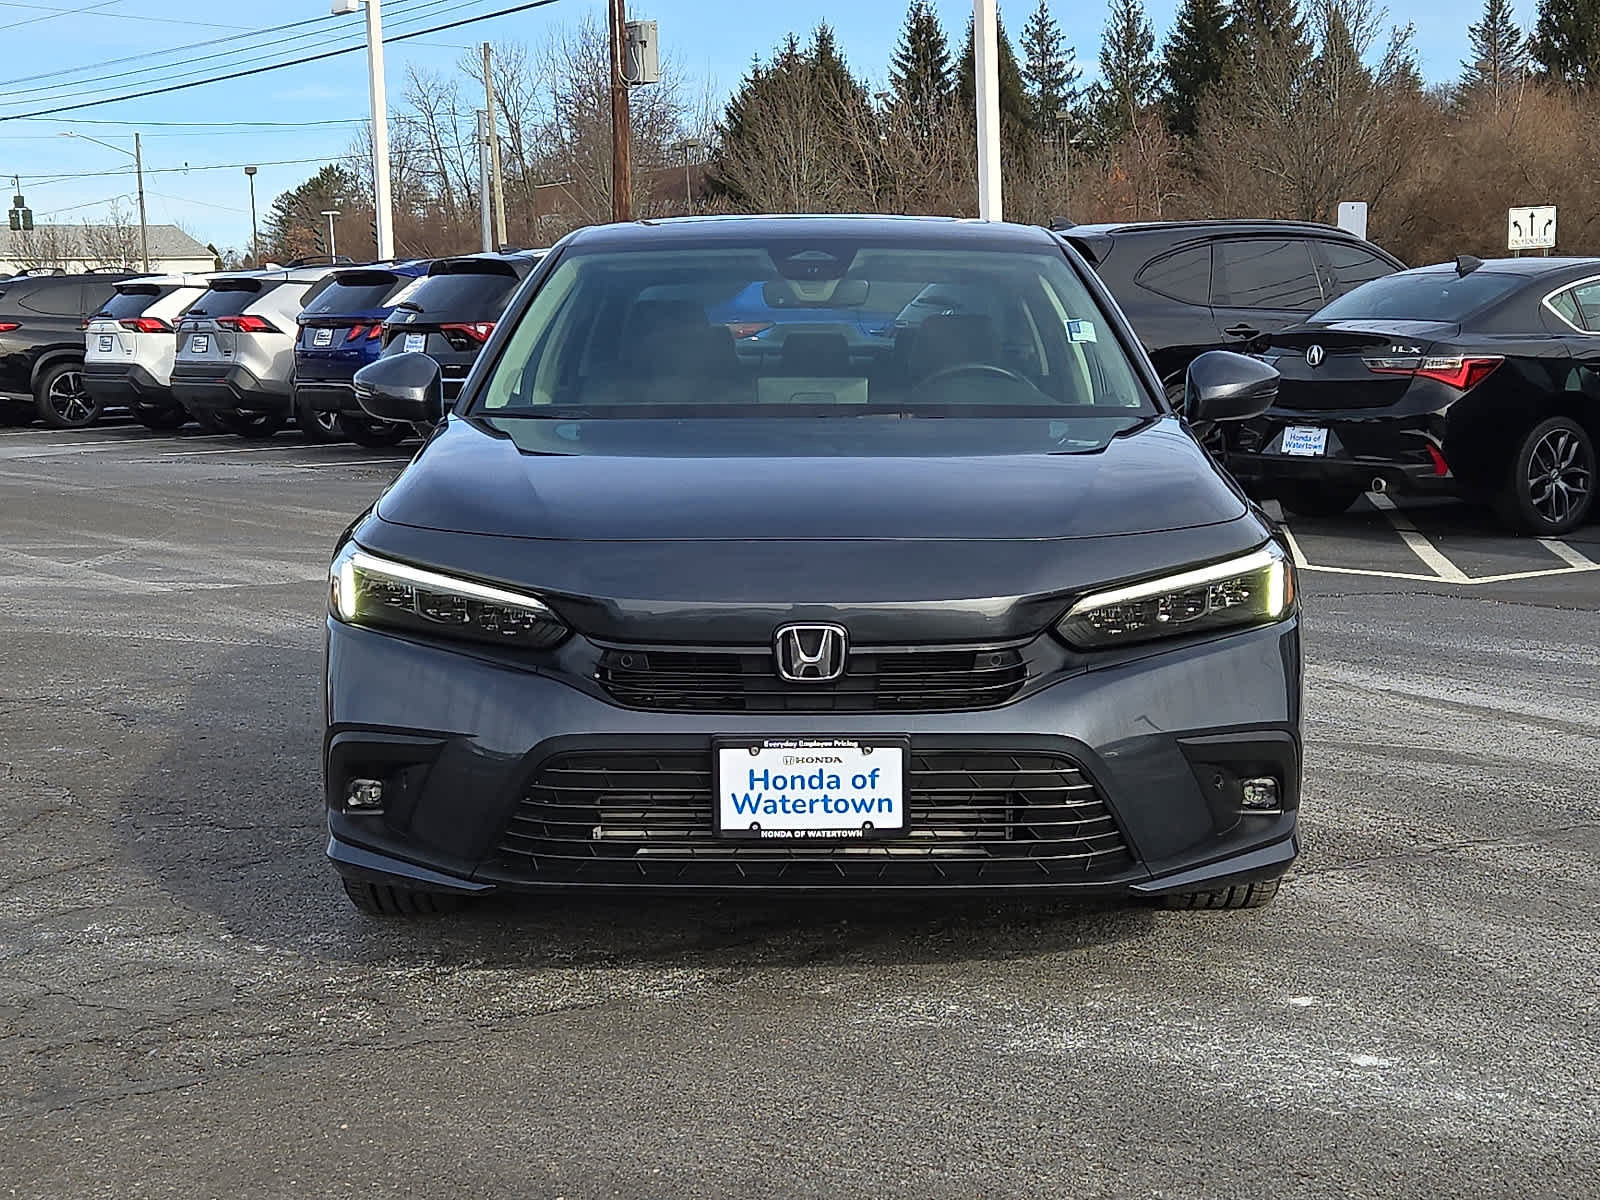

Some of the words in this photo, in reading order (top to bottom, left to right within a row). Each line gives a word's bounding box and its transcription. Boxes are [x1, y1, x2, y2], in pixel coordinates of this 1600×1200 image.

[1391, 345, 1422, 354] ILX
[763, 740, 797, 749] Everyday
[799, 740, 833, 748] Employee
[833, 740, 859, 748] Pricing
[796, 756, 843, 764] HONDA
[749, 768, 841, 791] Honda
[851, 768, 881, 790] of
[731, 792, 893, 815] Watertown
[761, 830, 793, 838] HONDA
[794, 830, 806, 838] OF
[807, 829, 863, 838] WATERTOWN
